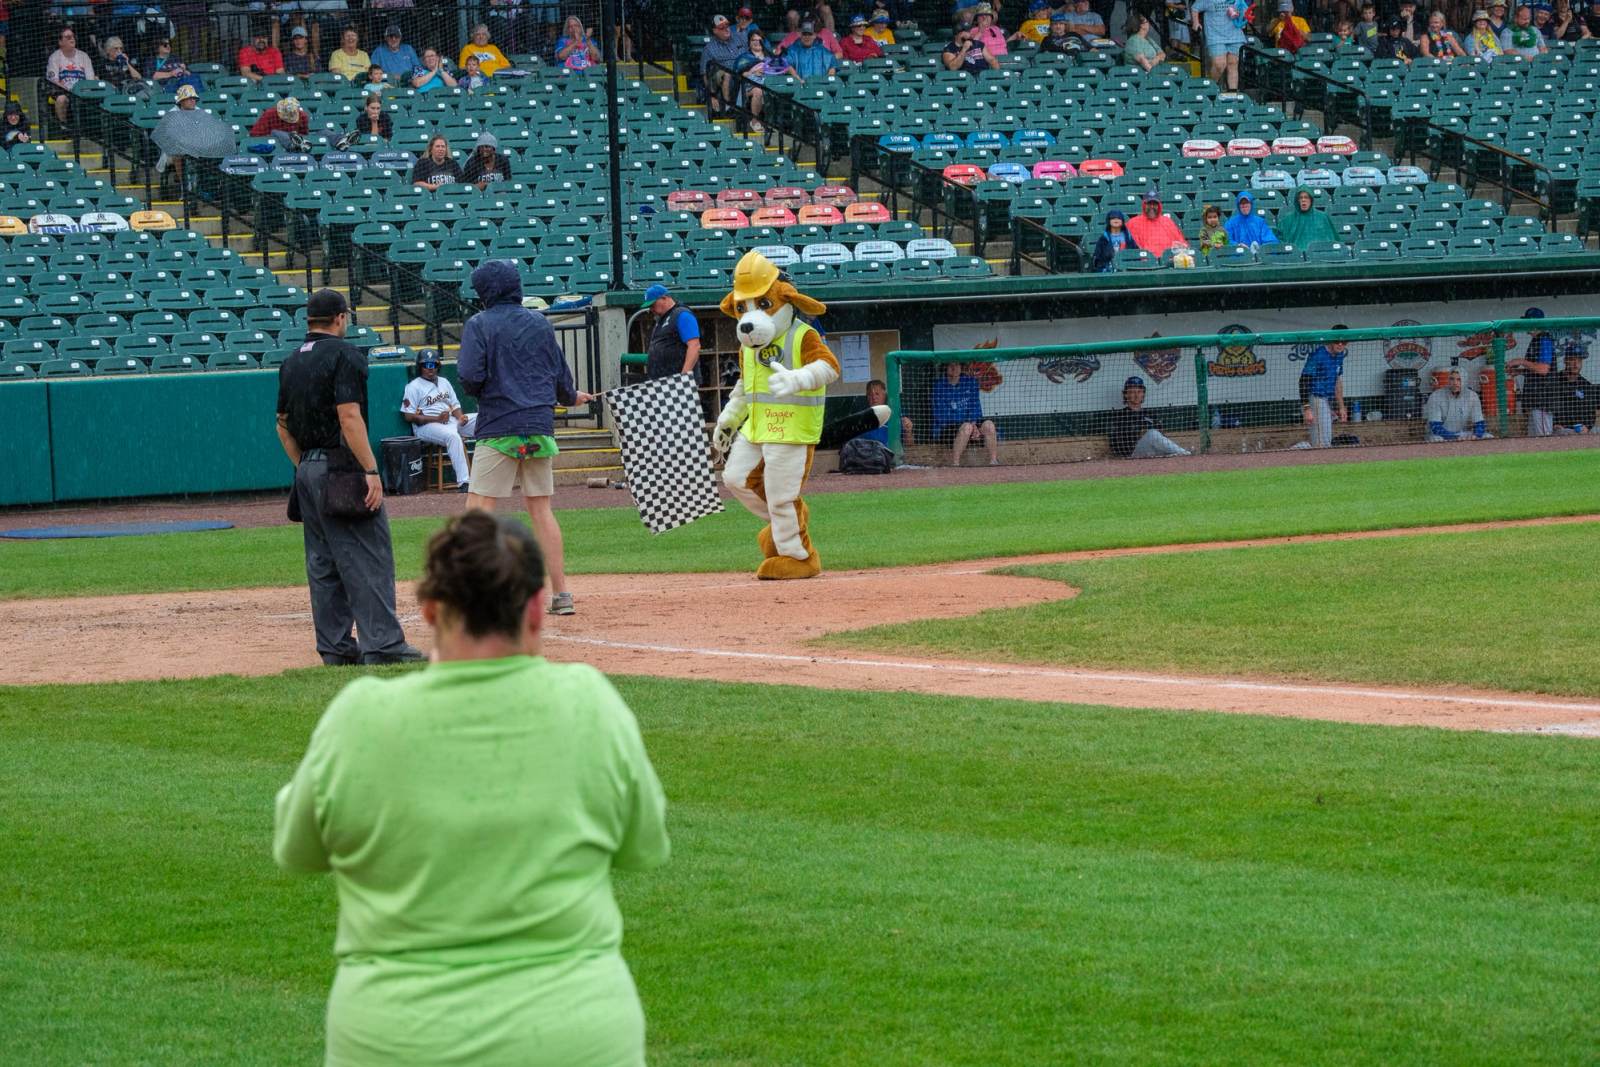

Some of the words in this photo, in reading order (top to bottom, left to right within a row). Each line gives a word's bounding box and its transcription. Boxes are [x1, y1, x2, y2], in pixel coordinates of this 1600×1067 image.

[427, 174, 456, 184] LEGENDS
[762, 346, 778, 359] 811
[764, 408, 795, 424] Digger
[767, 422, 785, 440] Dog
